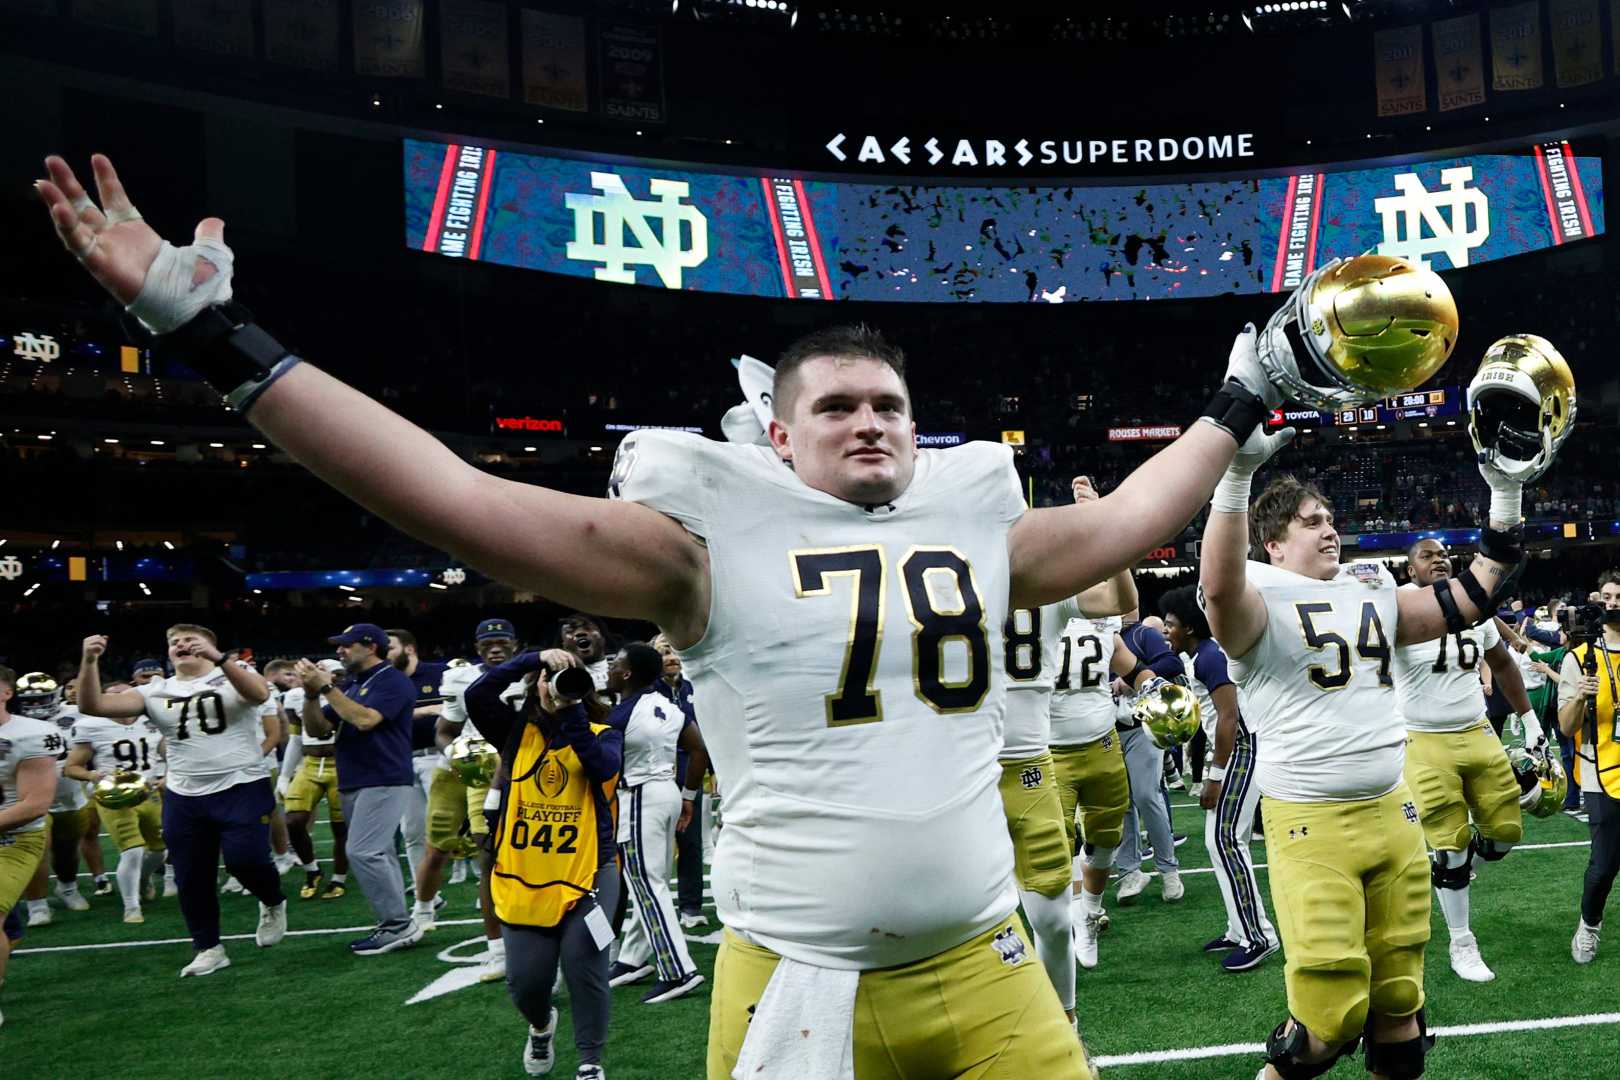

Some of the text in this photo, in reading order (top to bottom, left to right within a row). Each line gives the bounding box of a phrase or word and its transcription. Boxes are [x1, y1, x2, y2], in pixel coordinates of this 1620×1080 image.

[826, 132, 1255, 168] CAESARS SUPERDOME
[446, 171, 479, 229] FIGHTING
[1545, 148, 1583, 236] FIGHTING IRISH
[775, 185, 805, 237] FIGHTING
[1289, 197, 1312, 250] FIGHTING
[788, 240, 815, 276] IRISH
[1283, 252, 1305, 287] DAME
[496, 416, 563, 432] verizon
[1284, 410, 1320, 420] TOYOTA
[914, 434, 960, 445] Chevron
[1109, 427, 1181, 440] ROUSES MARKETS
[788, 543, 992, 727] 78
[1294, 601, 1394, 692] 54
[1055, 634, 1102, 691] 12
[167, 692, 227, 741] 70
[113, 737, 151, 771] 91
[517, 807, 582, 823] PLAYOFF
[511, 820, 579, 854] 042
